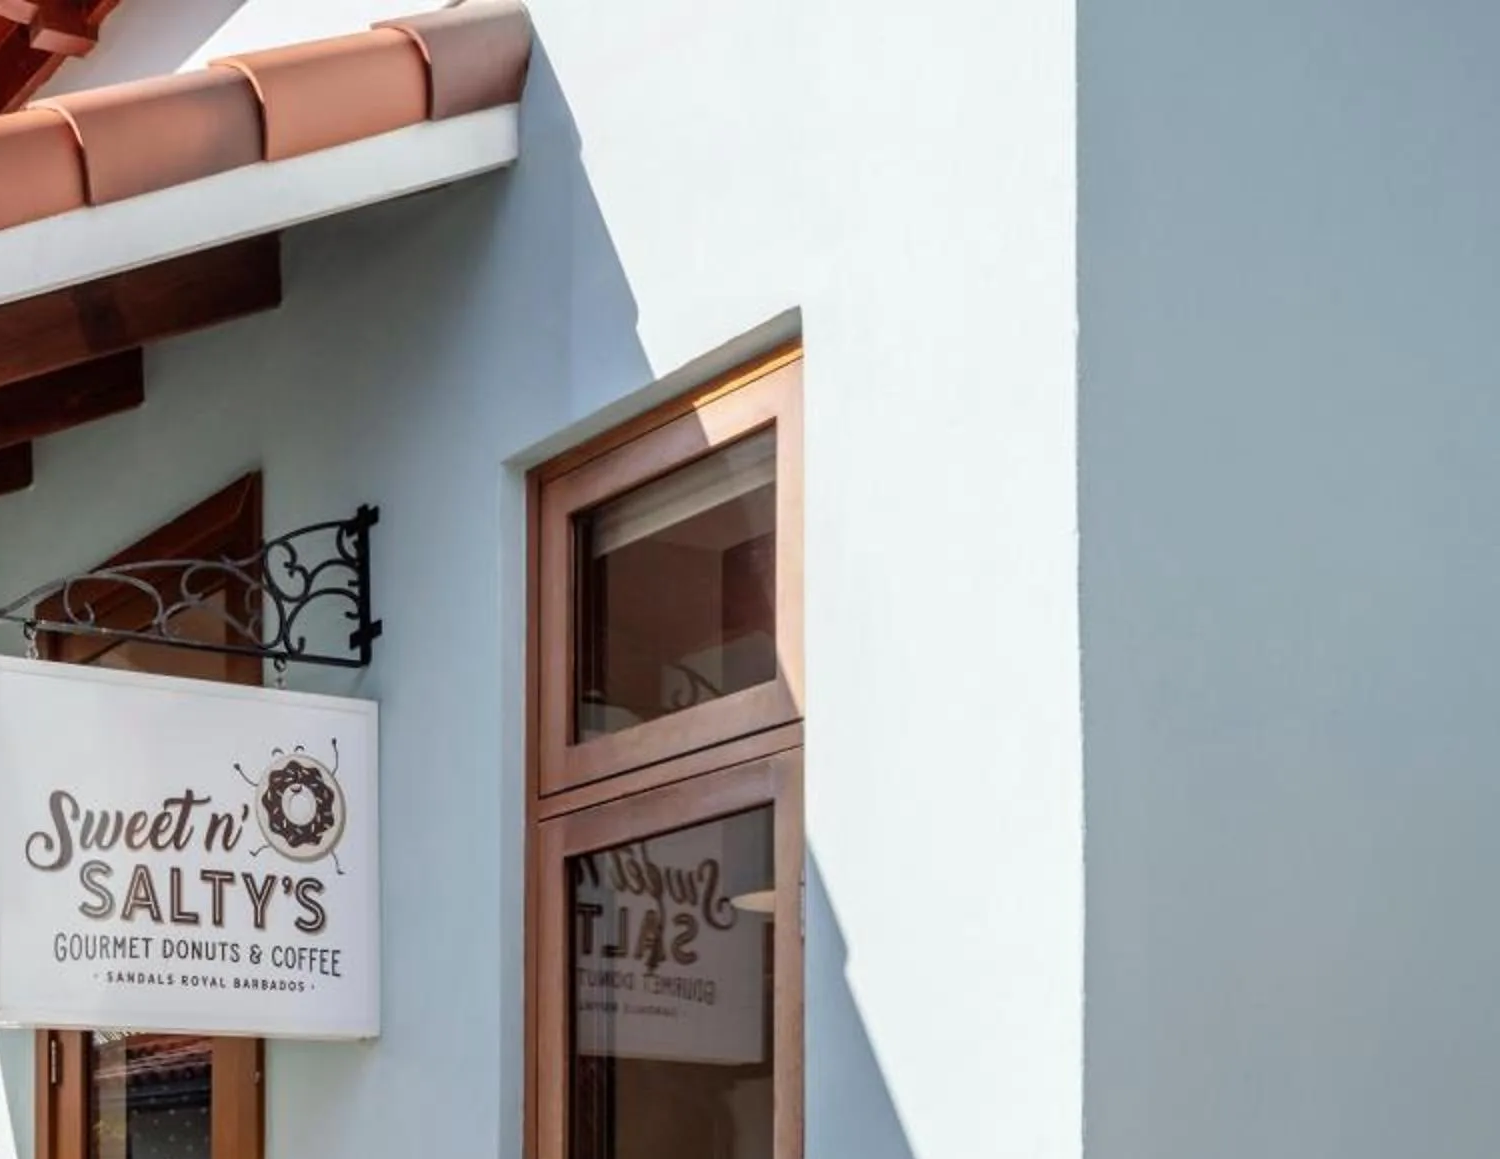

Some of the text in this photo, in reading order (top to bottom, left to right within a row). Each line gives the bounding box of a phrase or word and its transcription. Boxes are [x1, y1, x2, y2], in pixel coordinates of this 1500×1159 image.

[25, 788, 249, 872] Sweet n'
[78, 860, 328, 934] SALTY'S
[53, 933, 343, 978] GOURMET DONUTS & COFFEE
[106, 970, 307, 993] SANDALS ROYAL BARBADOS
